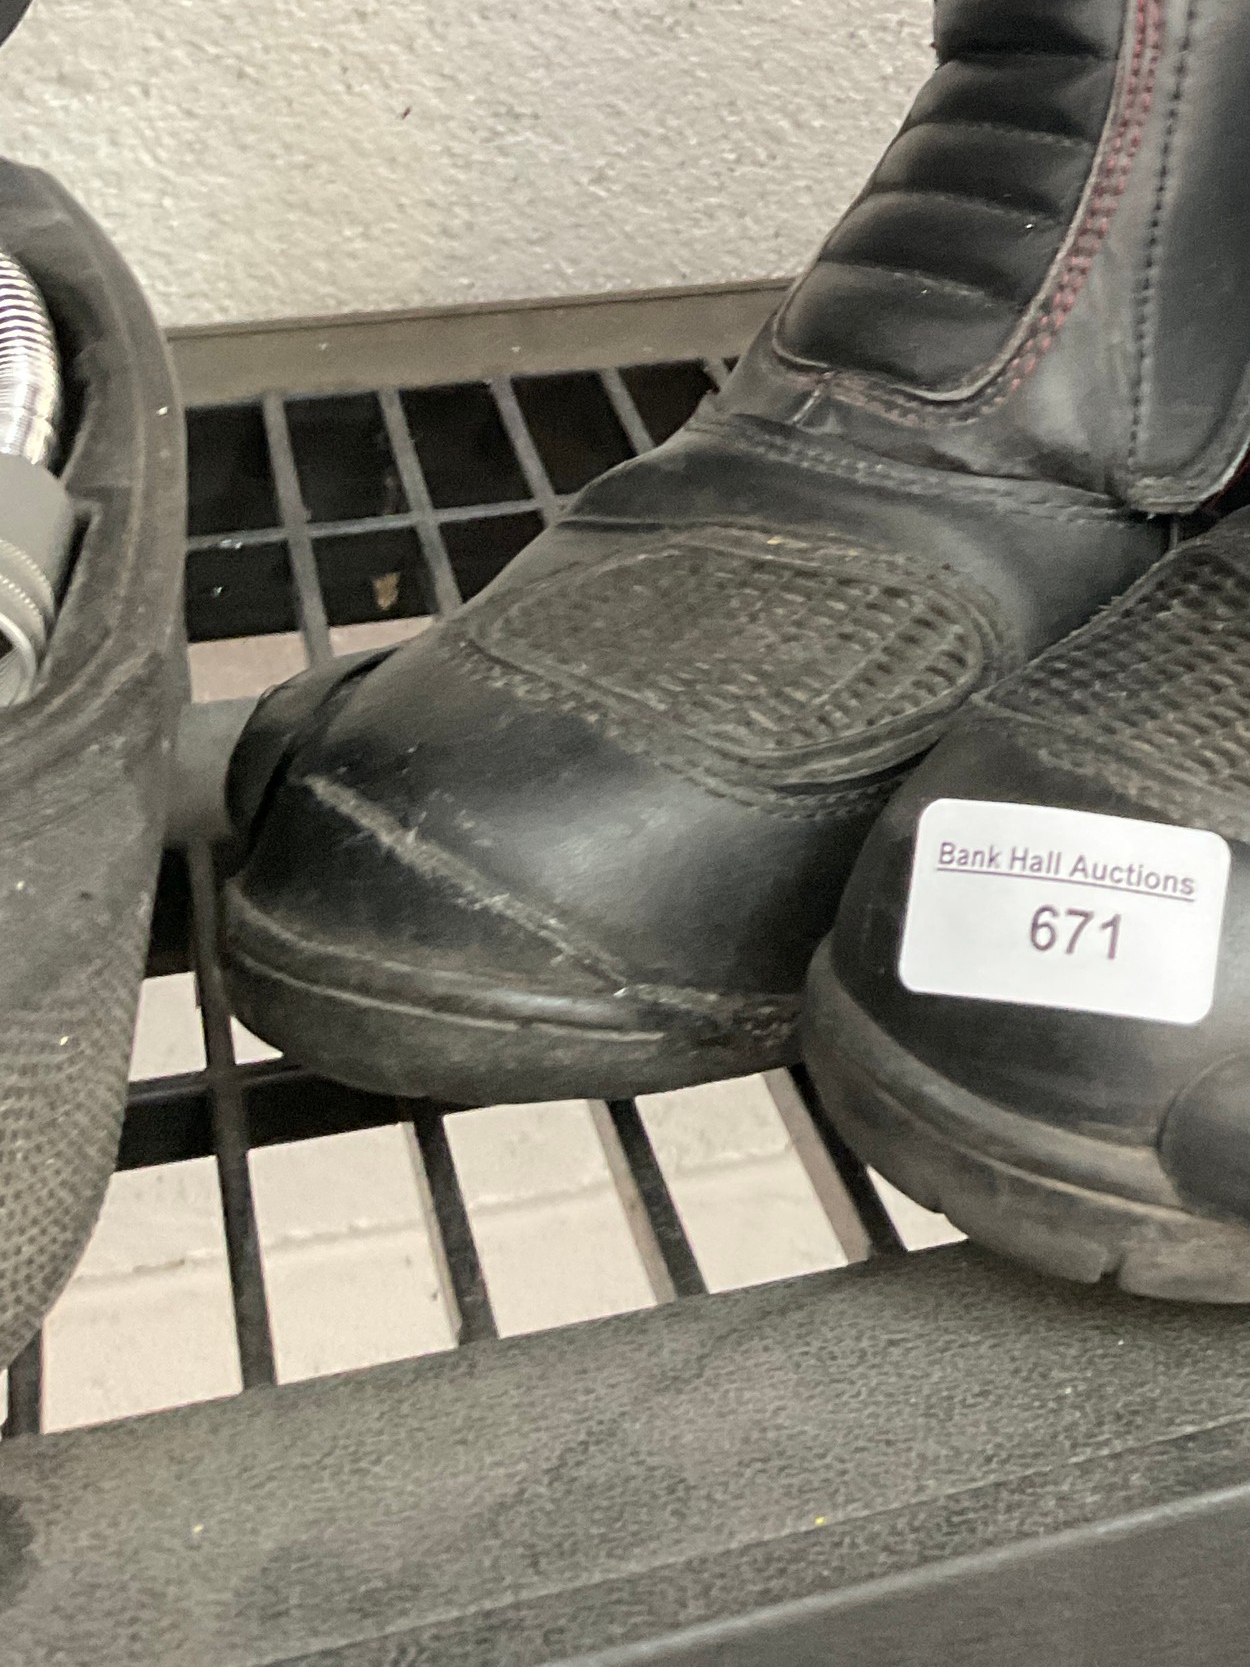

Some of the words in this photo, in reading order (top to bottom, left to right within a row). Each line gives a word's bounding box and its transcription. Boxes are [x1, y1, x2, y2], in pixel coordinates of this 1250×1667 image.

[938, 841, 1001, 868] Bank
[1009, 846, 1062, 875] Hall
[1070, 855, 1195, 896] Auctions
[1029, 904, 1122, 960] 671
